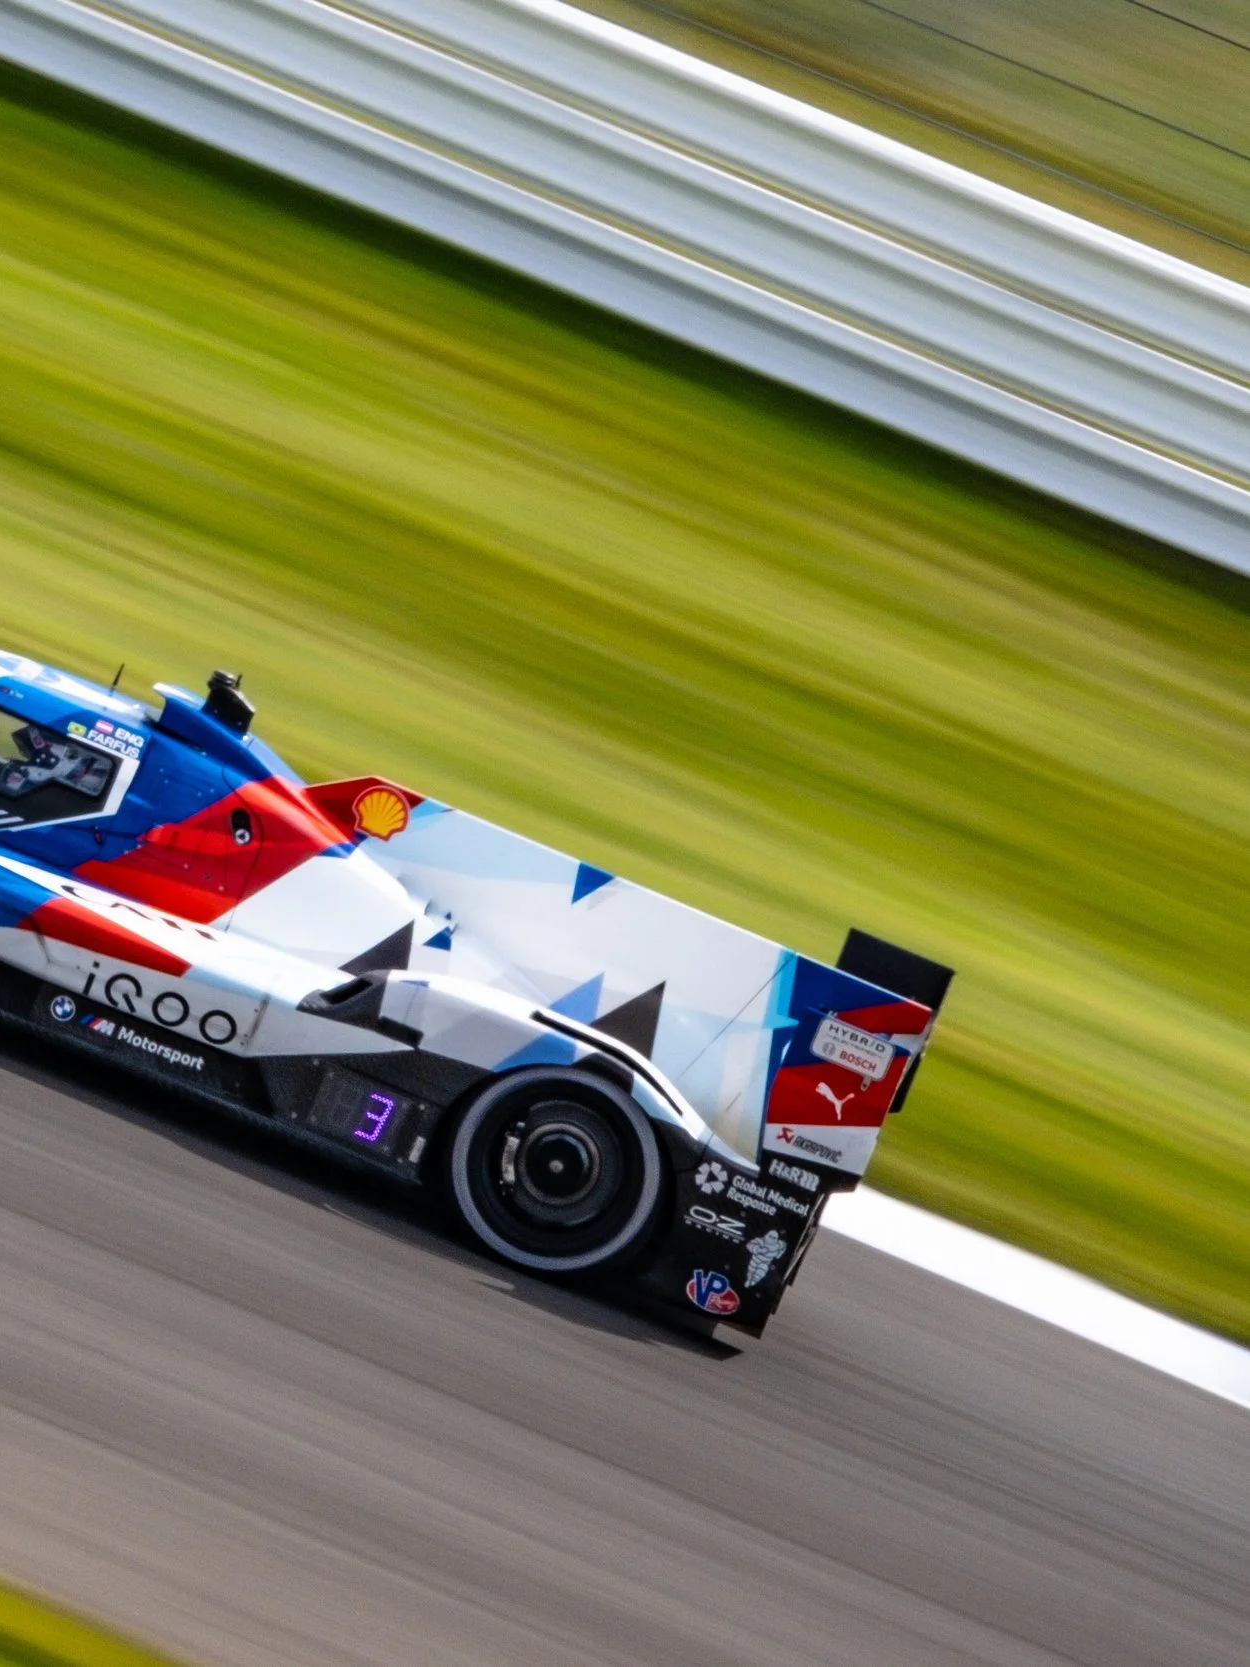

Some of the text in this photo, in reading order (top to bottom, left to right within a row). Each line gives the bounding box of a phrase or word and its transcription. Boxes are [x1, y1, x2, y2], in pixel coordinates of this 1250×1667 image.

[87, 729, 140, 759] FARFUS
[114, 727, 145, 749] ENG
[117, 1026, 205, 1071] Motorsport
[838, 1050, 877, 1073] BOSCH
[354, 1093, 394, 1141] 3
[726, 1186, 777, 1216] Response
[732, 1175, 810, 1217] Global Medical
[694, 1269, 730, 1308] VP
